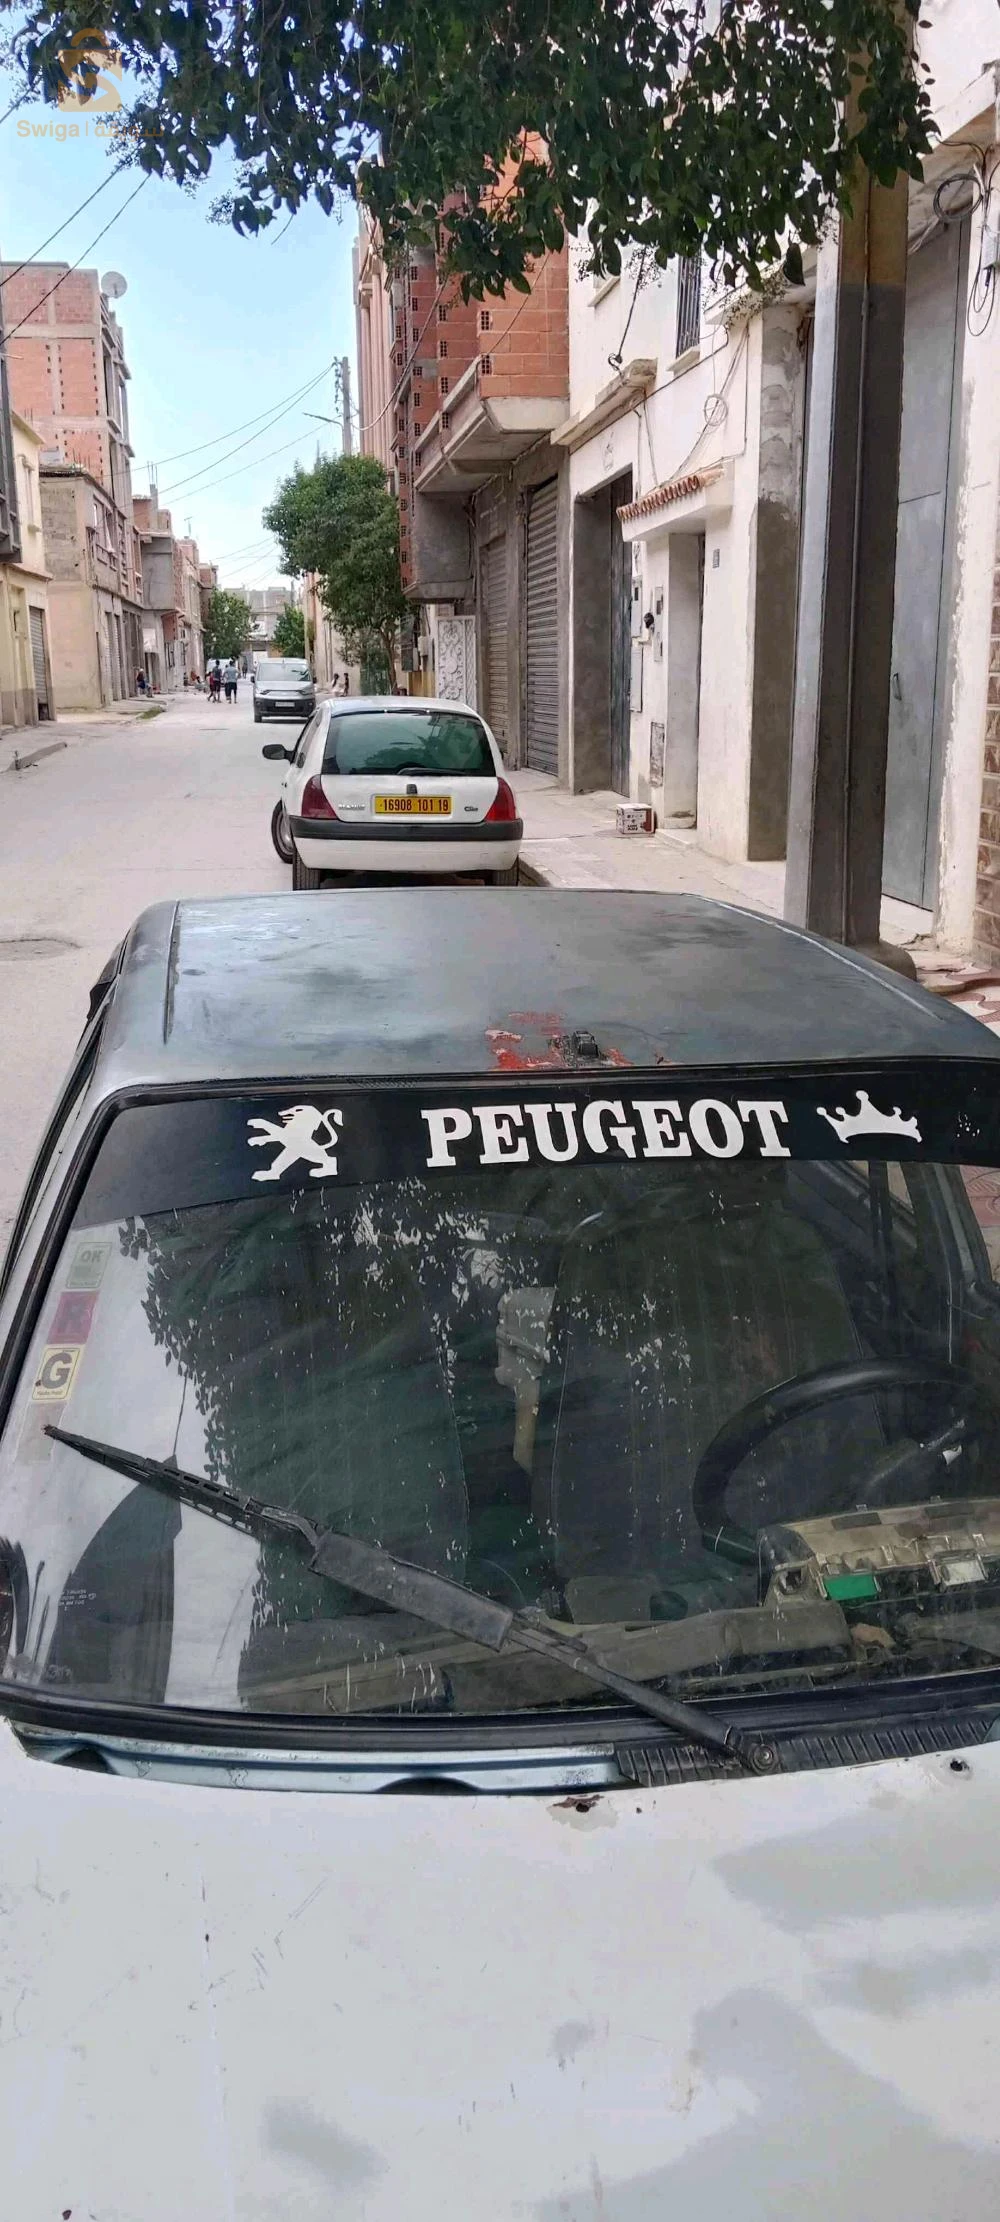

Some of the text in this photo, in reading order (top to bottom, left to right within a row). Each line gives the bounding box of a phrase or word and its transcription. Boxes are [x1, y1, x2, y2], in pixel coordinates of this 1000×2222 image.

[384, 799, 449, 812] 16908 101 19
[421, 1098, 792, 1168] PEUGEOT
[80, 1249, 104, 1264] OK
[41, 1352, 73, 1389] G
